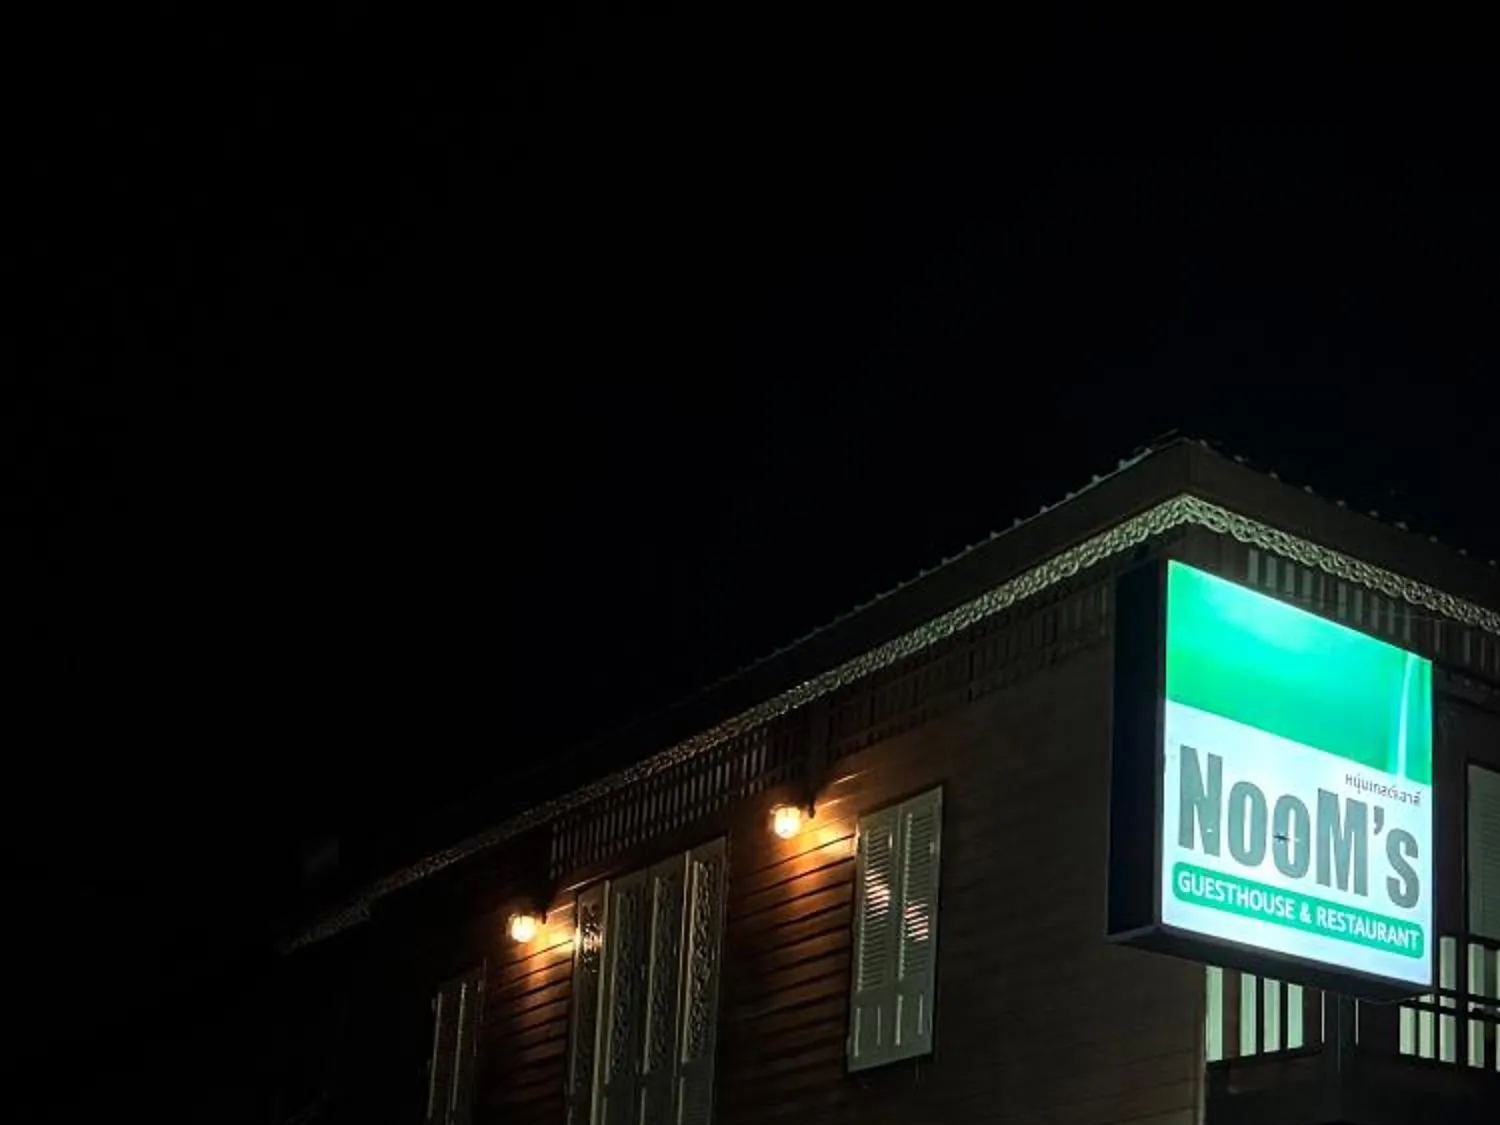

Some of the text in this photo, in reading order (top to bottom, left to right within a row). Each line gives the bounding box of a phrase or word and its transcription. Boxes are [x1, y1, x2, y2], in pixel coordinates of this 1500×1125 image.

[1178, 871, 1421, 950] GUESTHOUSE & RESTAURANT
